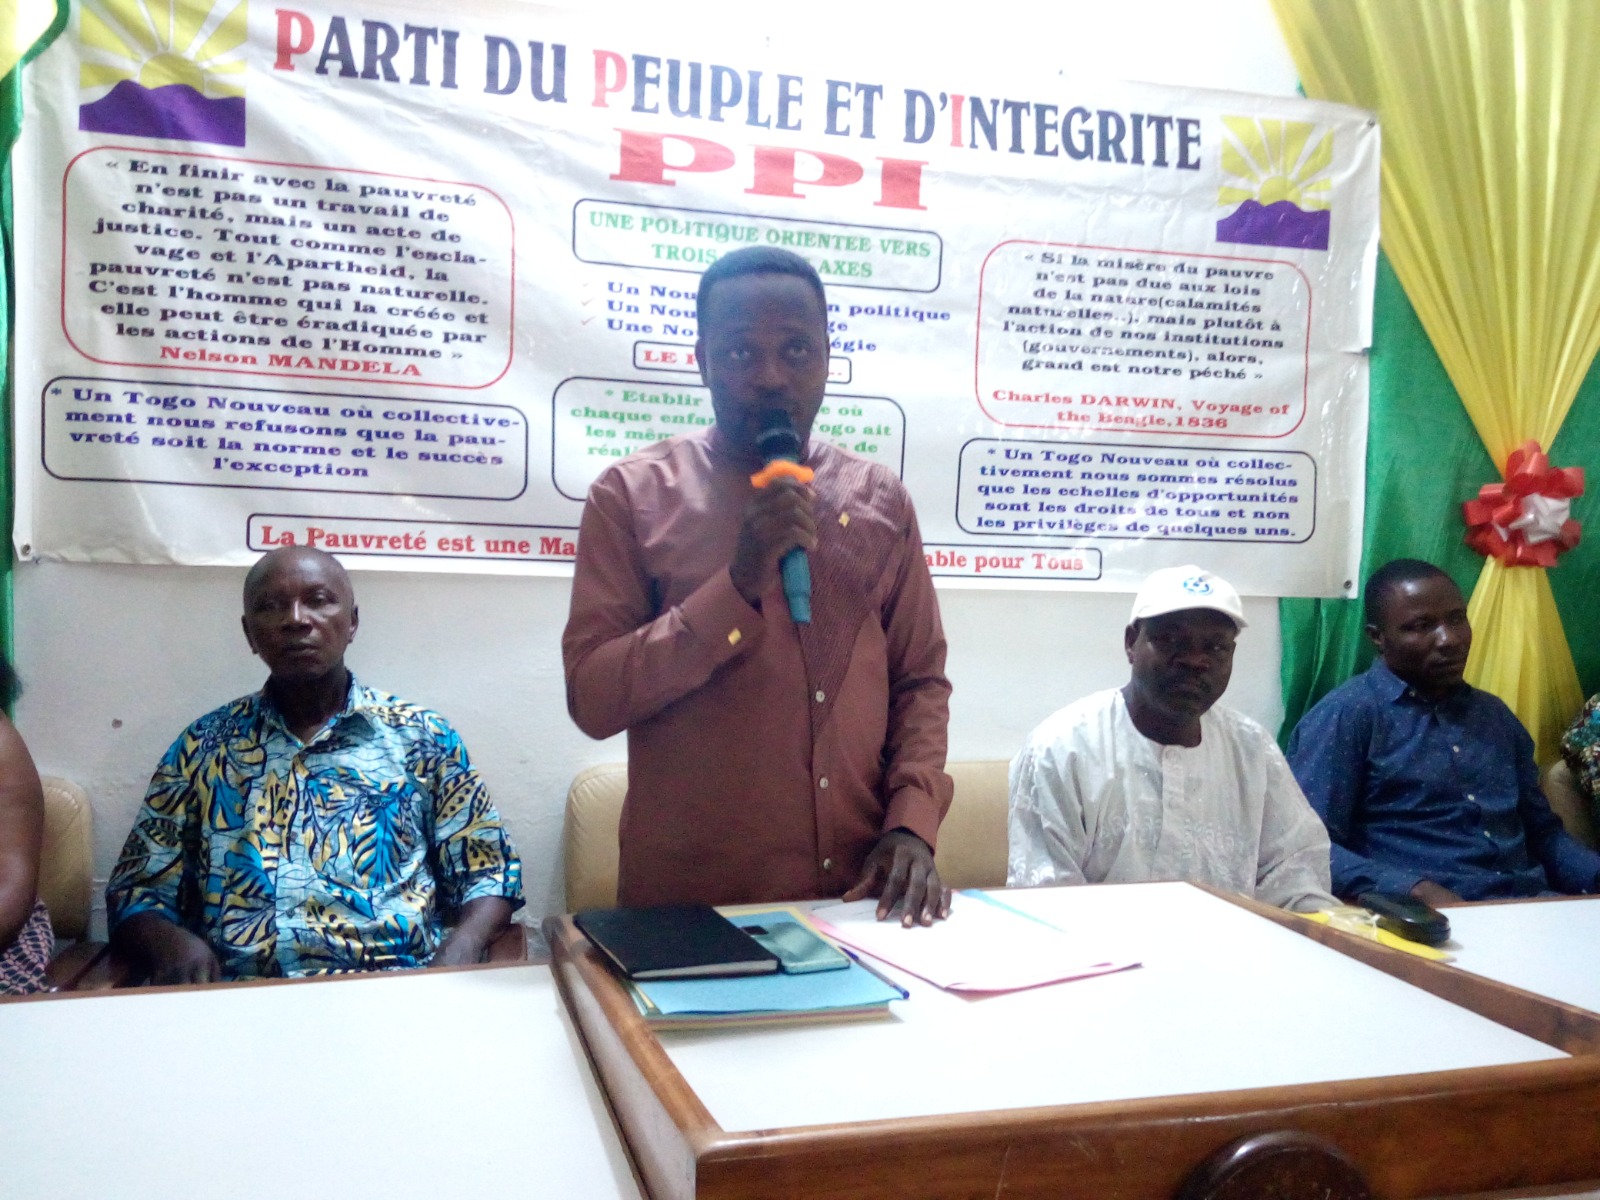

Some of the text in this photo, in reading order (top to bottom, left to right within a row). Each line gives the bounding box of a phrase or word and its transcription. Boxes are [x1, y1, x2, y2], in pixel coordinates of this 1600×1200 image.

[273, 9, 1201, 171] PARTI DU PEUPLE ET D'INTEGRITE
[609, 127, 930, 211] PPI
[127, 159, 476, 206] En finir avec la pauvreté
[134, 182, 449, 222] n'est pas un travail de
[244, 213, 313, 229] mais
[322, 222, 357, 234] un
[364, 225, 421, 240] acte
[429, 229, 461, 243] de
[589, 210, 932, 258] UNE POLITIQUE ORIENTEE VERS
[212, 228, 281, 246] Tout
[289, 238, 386, 256] comme
[394, 244, 486, 265] l'escla-
[651, 243, 717, 265] TROIS
[133, 244, 200, 262] vage
[209, 250, 237, 263] et
[424, 267, 449, 283] la
[818, 259, 872, 278] AXES
[1070, 254, 1089, 266] la
[1172, 261, 1198, 275] du
[1205, 267, 1274, 281] pauvre
[88, 262, 216, 282] pauvreté
[226, 271, 293, 288] n'est
[302, 279, 351, 293] pas
[607, 281, 640, 296] Un
[1035, 270, 1261, 297] n'est pas due aux lois
[87, 279, 158, 297] C'est
[168, 285, 288, 307] l'homme
[296, 298, 342, 313] qui
[352, 300, 377, 314] la
[464, 312, 489, 325] et
[1032, 287, 1057, 300] de
[1063, 289, 1083, 302] la
[607, 299, 640, 314] Un
[848, 304, 951, 322] politique
[99, 301, 487, 344] elle peut être éradiquée par
[606, 318, 653, 333] Une
[1146, 314, 1197, 326] mais
[1203, 316, 1264, 331] plutôt
[115, 322, 442, 359] les actions de l'Homme
[1002, 320, 1284, 349] l'action de nos institutions
[159, 346, 420, 377] Nelson MANDELA
[643, 350, 678, 364] LE
[1021, 358, 1246, 380] grand est notre péché
[72, 388, 519, 428] Un Togo Nouveau où collective-
[621, 390, 704, 407] Etablir
[991, 389, 1073, 405] Charles
[1191, 399, 1263, 417] Voyage
[1268, 403, 1290, 415] of
[570, 406, 717, 427] chaque enfa
[1056, 410, 1091, 423] the
[64, 411, 505, 447] ment nous refusons que la pau-
[585, 425, 617, 439] les
[862, 424, 892, 437] ait
[68, 431, 503, 465] vreté soit la norme et le succès
[854, 441, 878, 453] de
[212, 456, 369, 478] l'exception
[1004, 448, 1292, 471] Un Togo Nouveau où collec-
[979, 465, 1298, 488] tivement nous sommes résolus
[976, 484, 1015, 497] que
[1022, 483, 1051, 496] les
[1057, 485, 1140, 499] echelles
[984, 501, 1290, 520] sont les droits de tous et non
[976, 516, 1006, 528] les
[1124, 521, 1150, 533] de
[1156, 522, 1248, 538] quelques
[261, 525, 296, 546] La
[306, 527, 427, 551] Pauvreté
[437, 534, 476, 553] est
[484, 538, 531, 555] une
[974, 556, 1025, 573] pour
[1031, 553, 1084, 571] Tous
